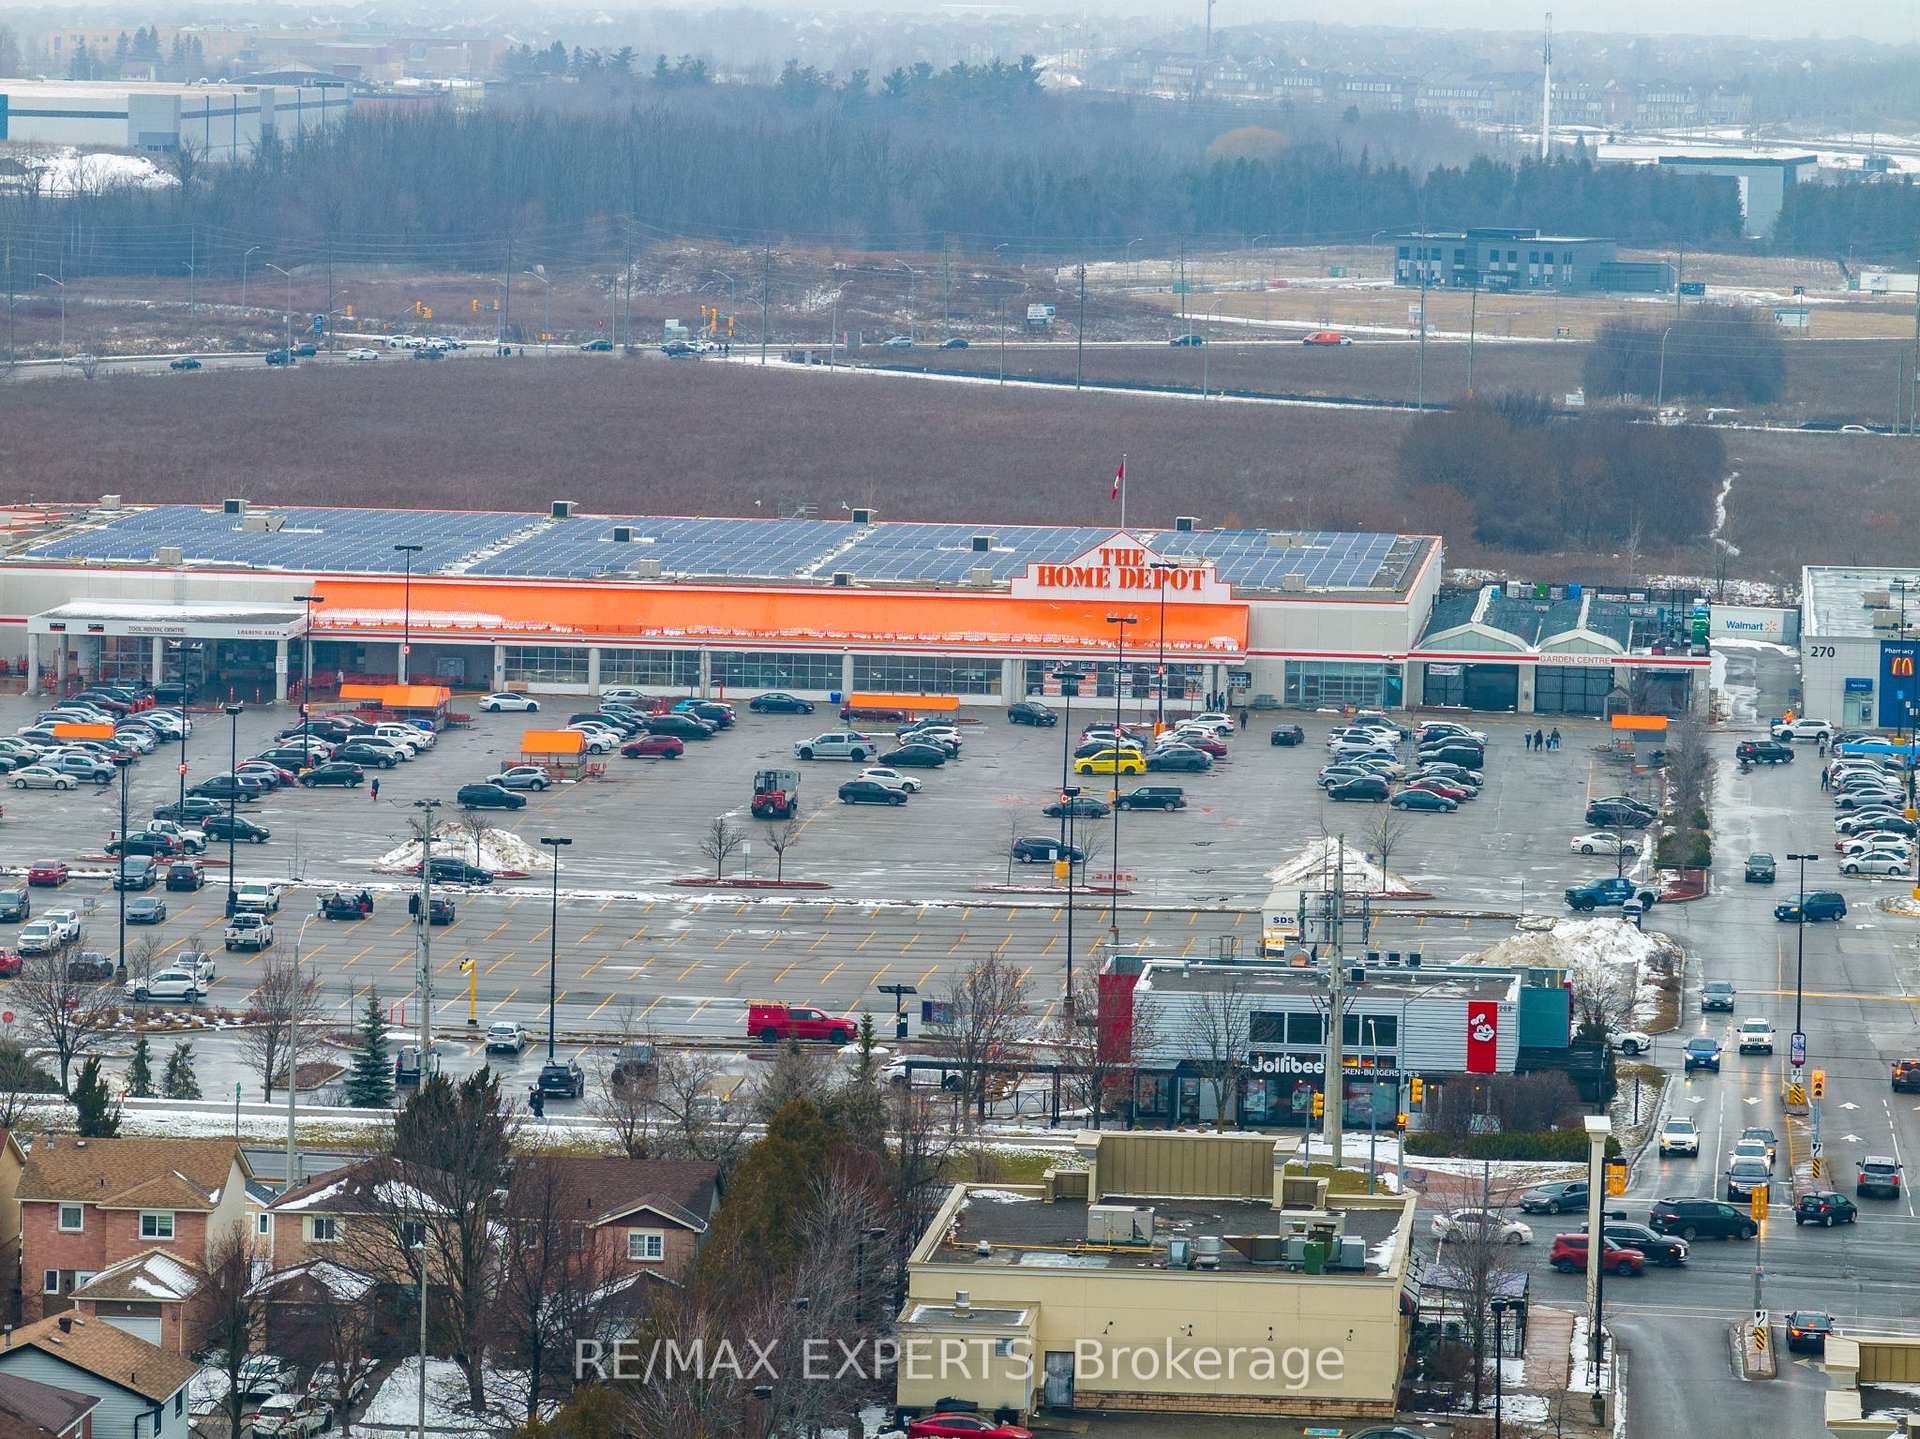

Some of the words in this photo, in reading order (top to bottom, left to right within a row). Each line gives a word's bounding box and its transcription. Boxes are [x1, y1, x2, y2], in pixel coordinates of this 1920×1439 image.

[1099, 547, 1145, 567] THE
[1037, 565, 1111, 588] HOME
[1118, 567, 1205, 591] DEPOT
[1726, 620, 1763, 631] Walmart
[403, 645, 410, 654] D
[1810, 646, 1835, 658] 270
[1540, 655, 1575, 664] GARDEN
[1577, 656, 1611, 664] CENTRE
[1158, 665, 1164, 674] A
[303, 704, 309, 712] E
[1114, 729, 1121, 738] B
[179, 765, 186, 774] F
[1061, 794, 1068, 803] C
[1252, 1056, 1325, 1074] Jollibee
